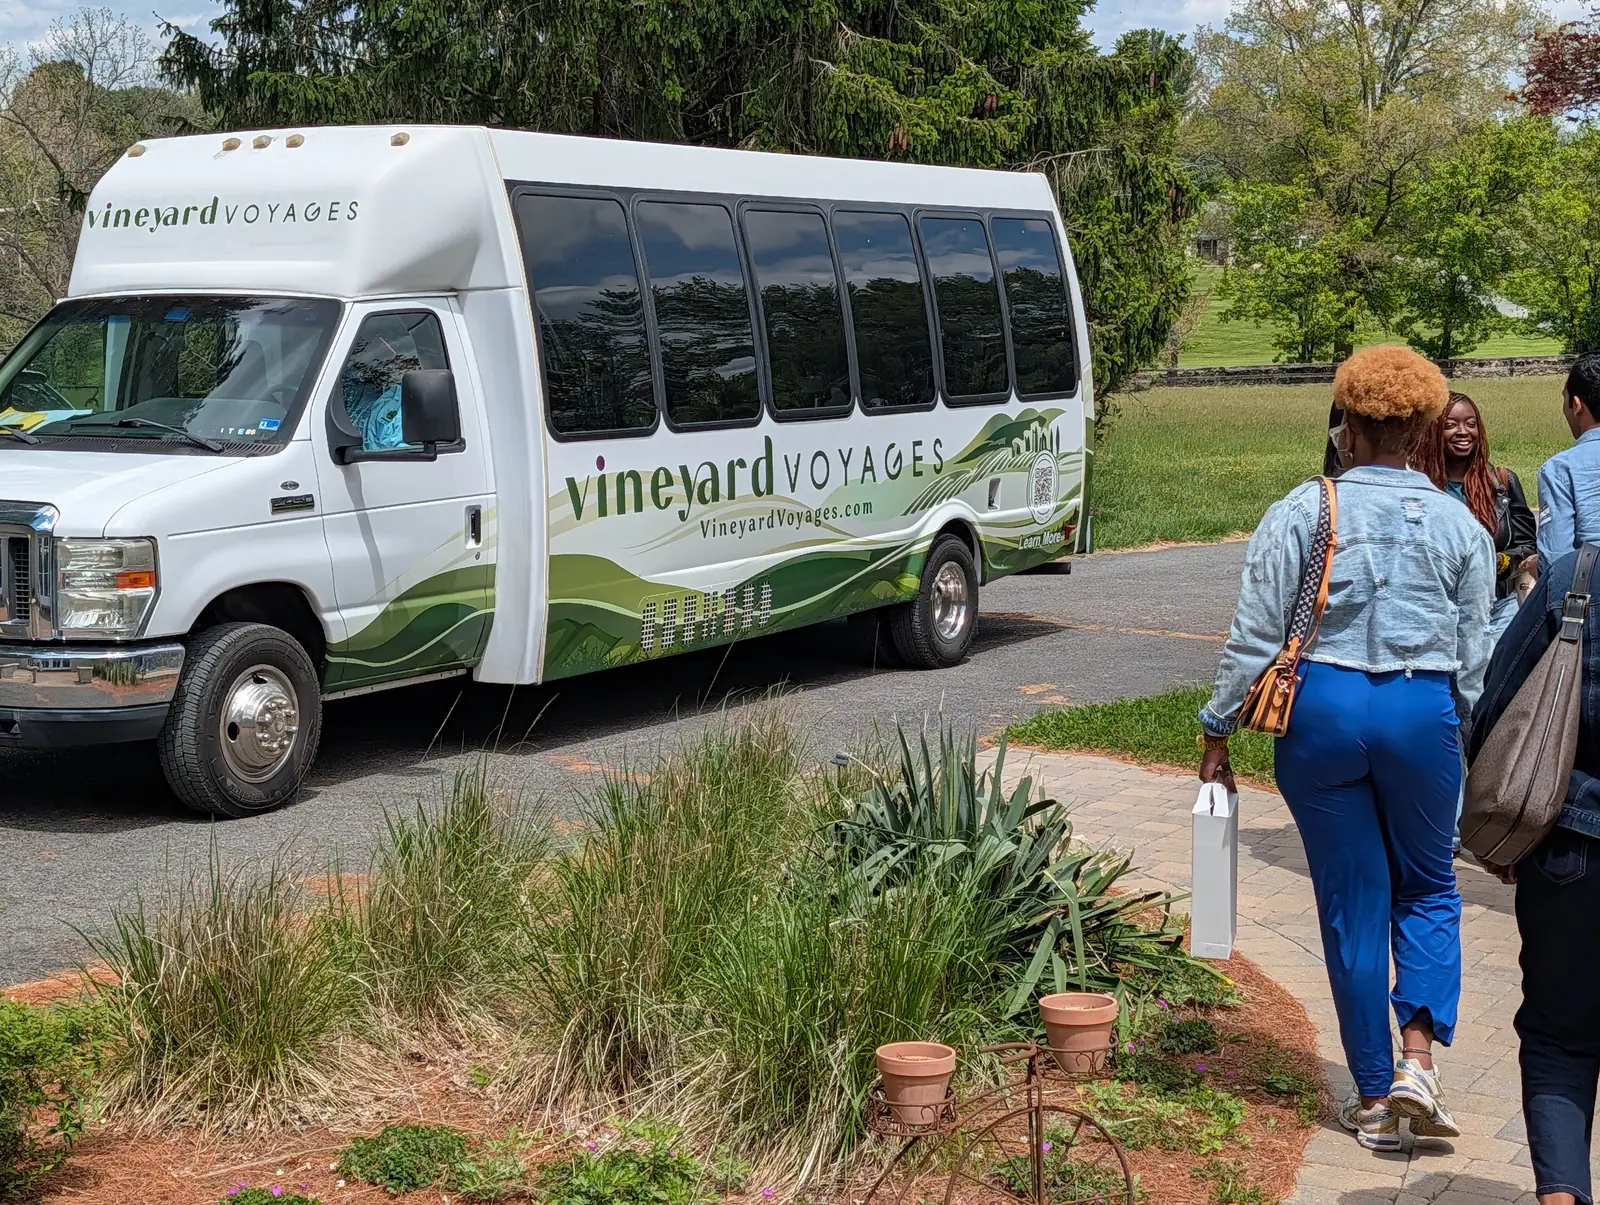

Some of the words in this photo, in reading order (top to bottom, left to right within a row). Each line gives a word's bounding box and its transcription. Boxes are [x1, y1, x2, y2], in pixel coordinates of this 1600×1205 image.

[87, 195, 219, 233] vineyard
[225, 201, 359, 225] VOYAGES
[564, 435, 774, 523] vineyard
[783, 438, 944, 494] VOYAGES
[700, 501, 873, 539] VineyardVoyages.com
[1018, 534, 1041, 550] Learn
[1042, 530, 1061, 546] More
